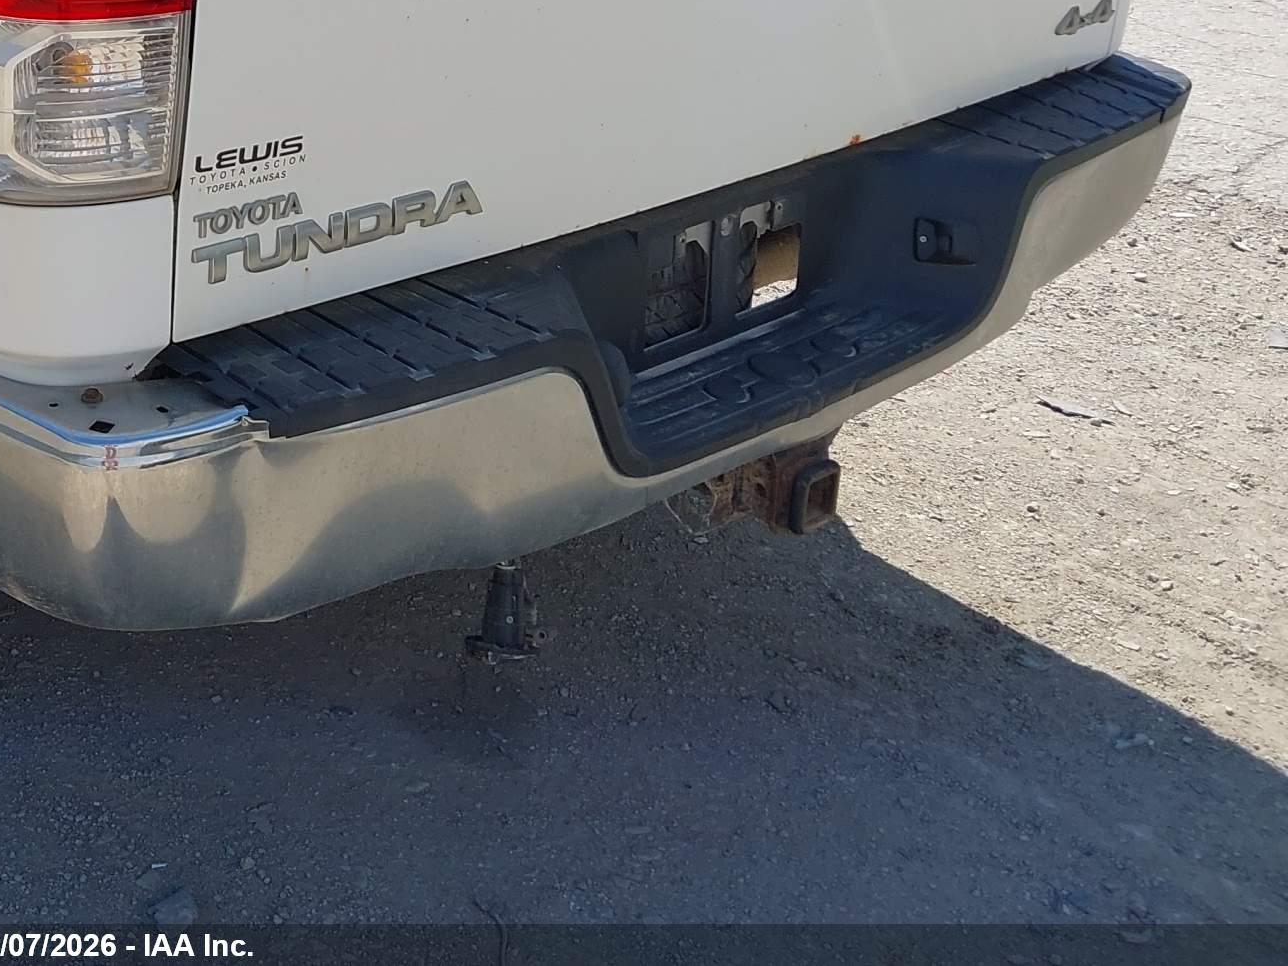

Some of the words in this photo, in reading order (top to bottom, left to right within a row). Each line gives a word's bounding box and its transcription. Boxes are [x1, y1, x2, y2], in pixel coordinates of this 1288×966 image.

[189, 166, 247, 186] TOYOTA
[263, 153, 307, 171] SCION
[194, 135, 304, 173] LEWIS
[205, 180, 247, 194] TOPEKA,
[249, 170, 287, 185] KANSAS
[191, 180, 483, 284] TUNDRA
[193, 192, 303, 238] TOYOTA
